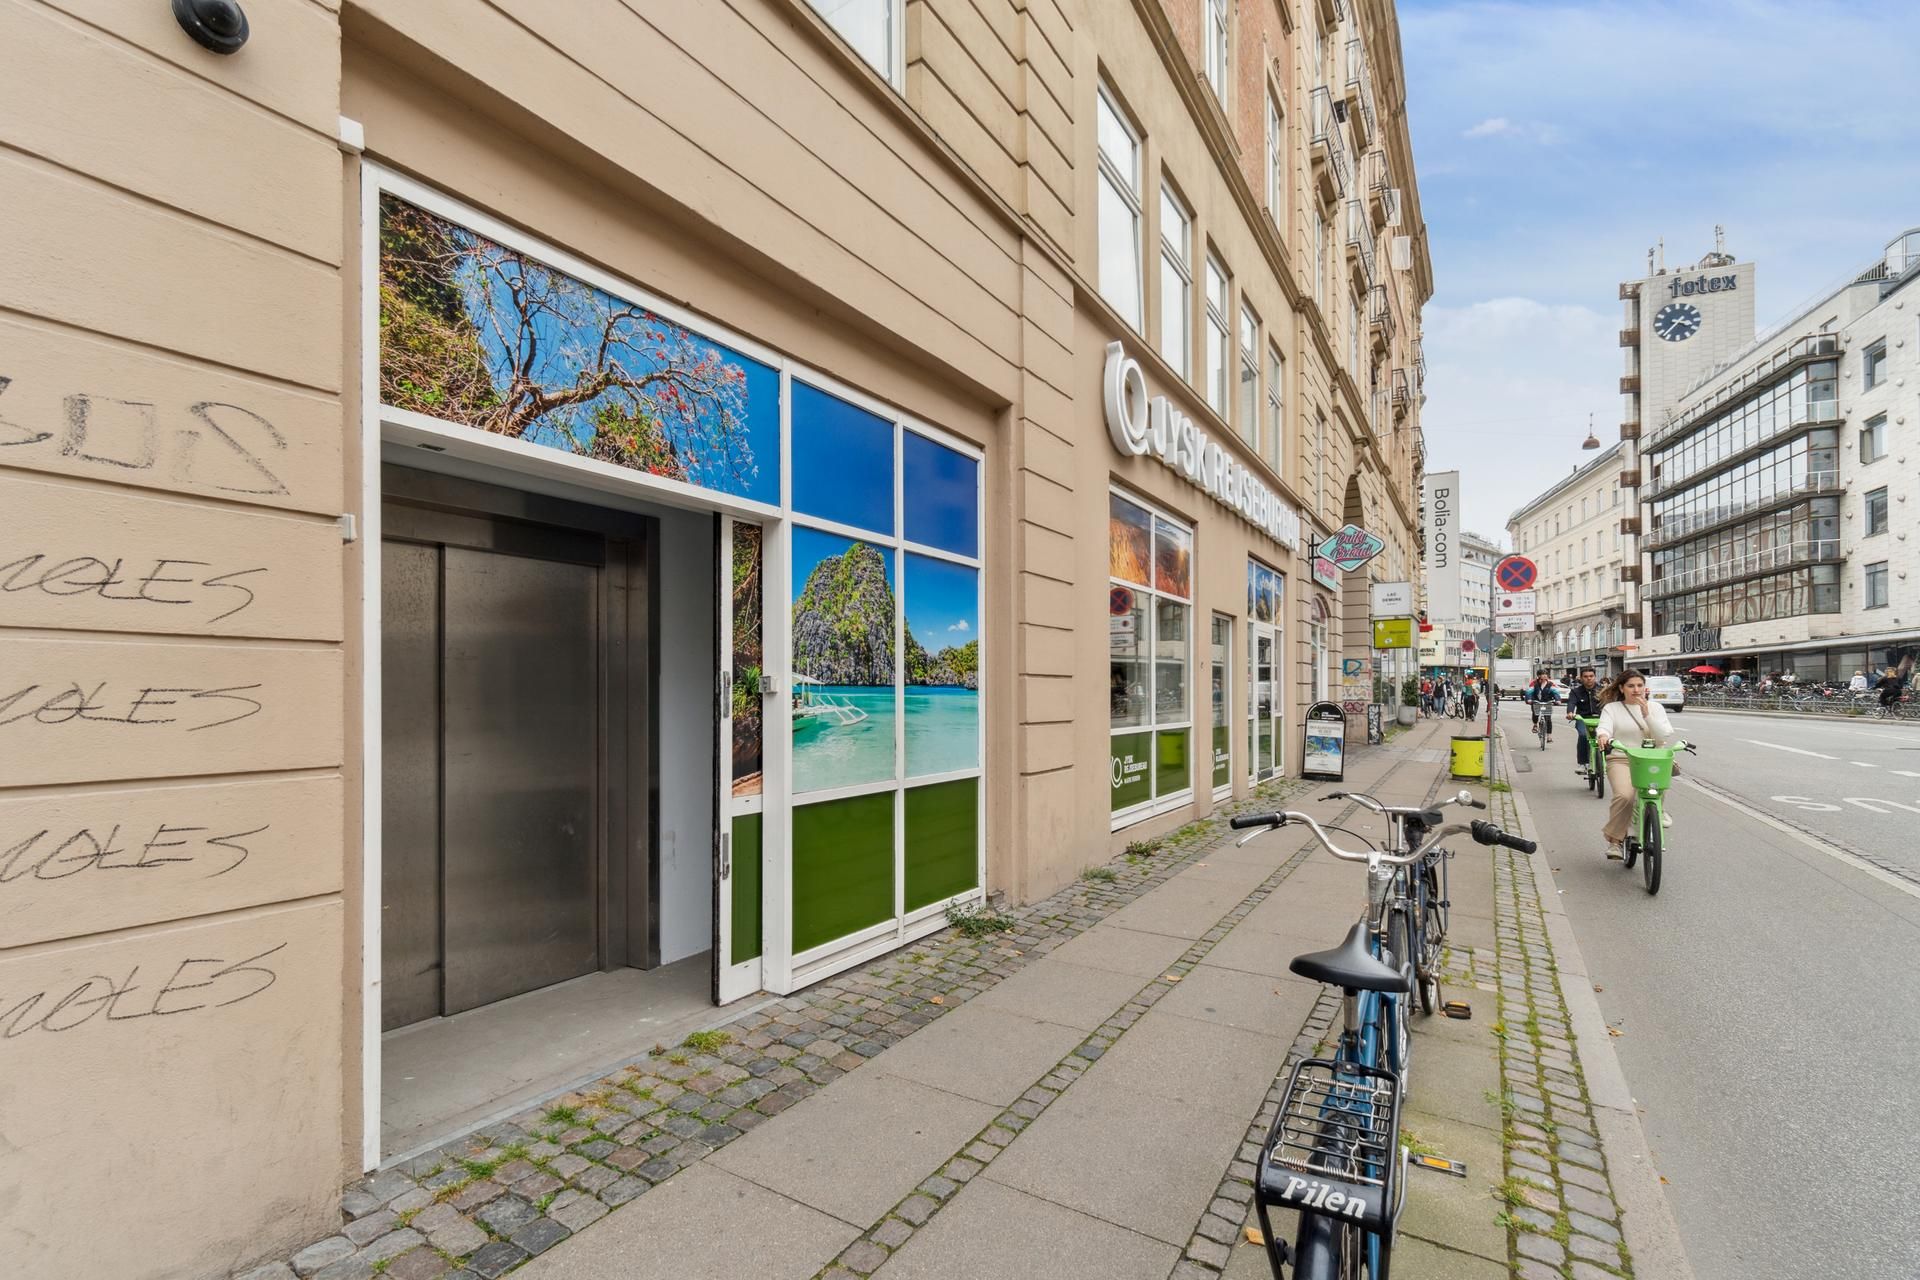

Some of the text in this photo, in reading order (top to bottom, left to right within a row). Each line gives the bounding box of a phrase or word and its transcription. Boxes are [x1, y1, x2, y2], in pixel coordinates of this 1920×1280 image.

[1147, 396, 1208, 488] JYSK
[1434, 487, 1451, 569] Bolia.com
[1280, 1175, 1367, 1219] Pilen
